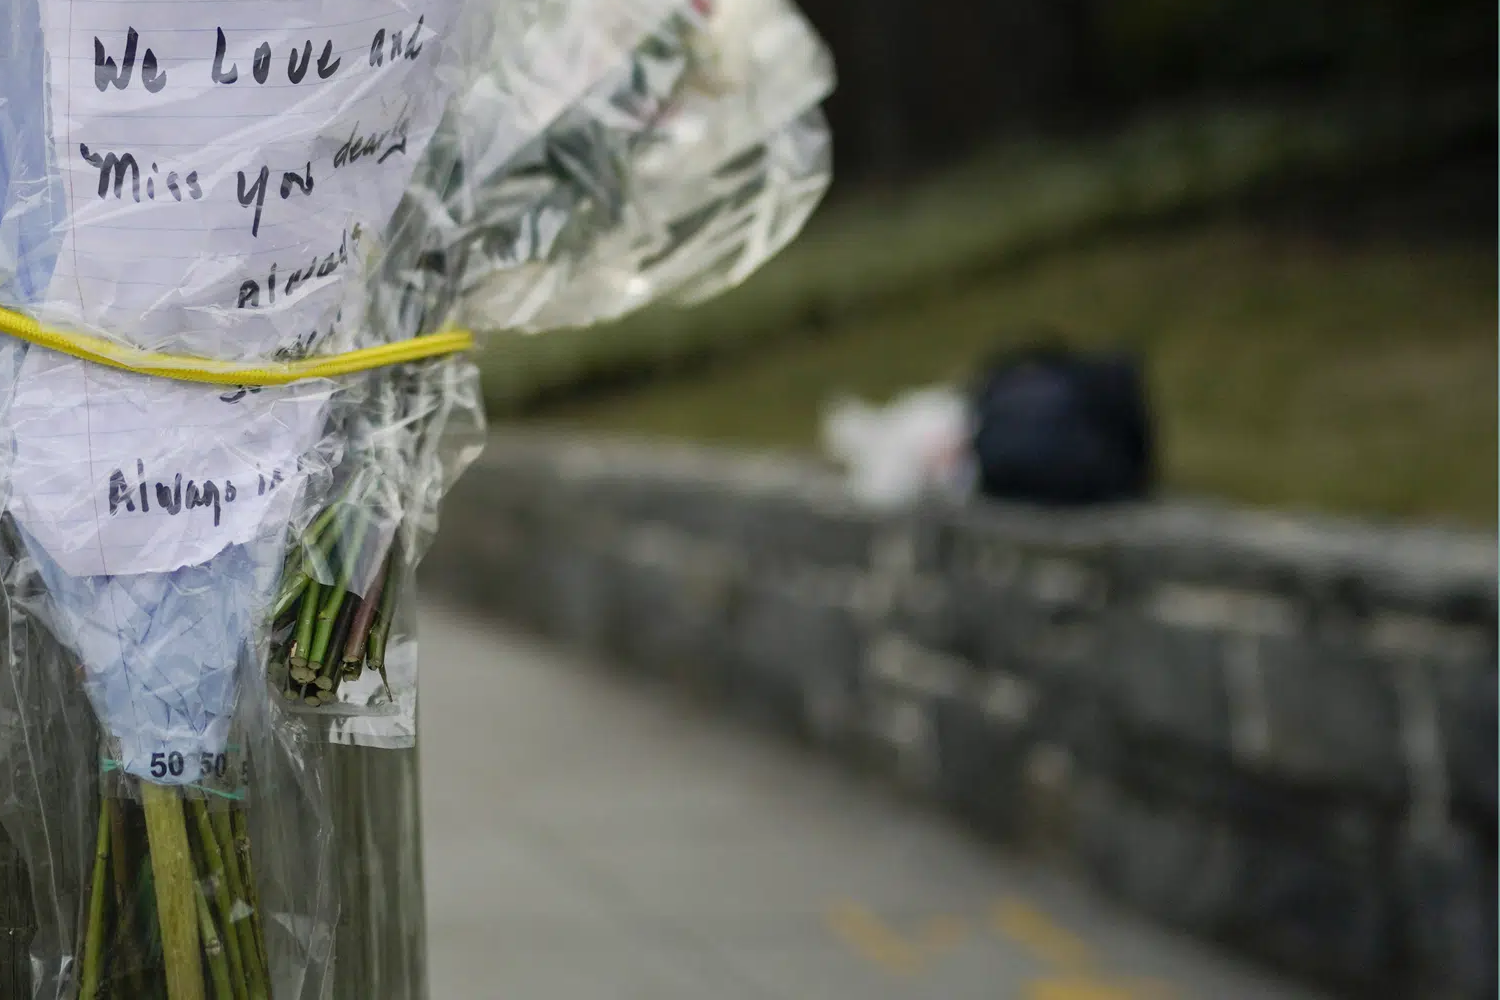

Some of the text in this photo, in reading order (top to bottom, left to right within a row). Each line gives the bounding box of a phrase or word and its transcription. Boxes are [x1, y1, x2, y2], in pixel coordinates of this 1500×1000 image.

[94, 14, 425, 93] We Love and
[80, 142, 203, 203] Miss
[150, 751, 185, 778] 50
[200, 751, 227, 778] 50
